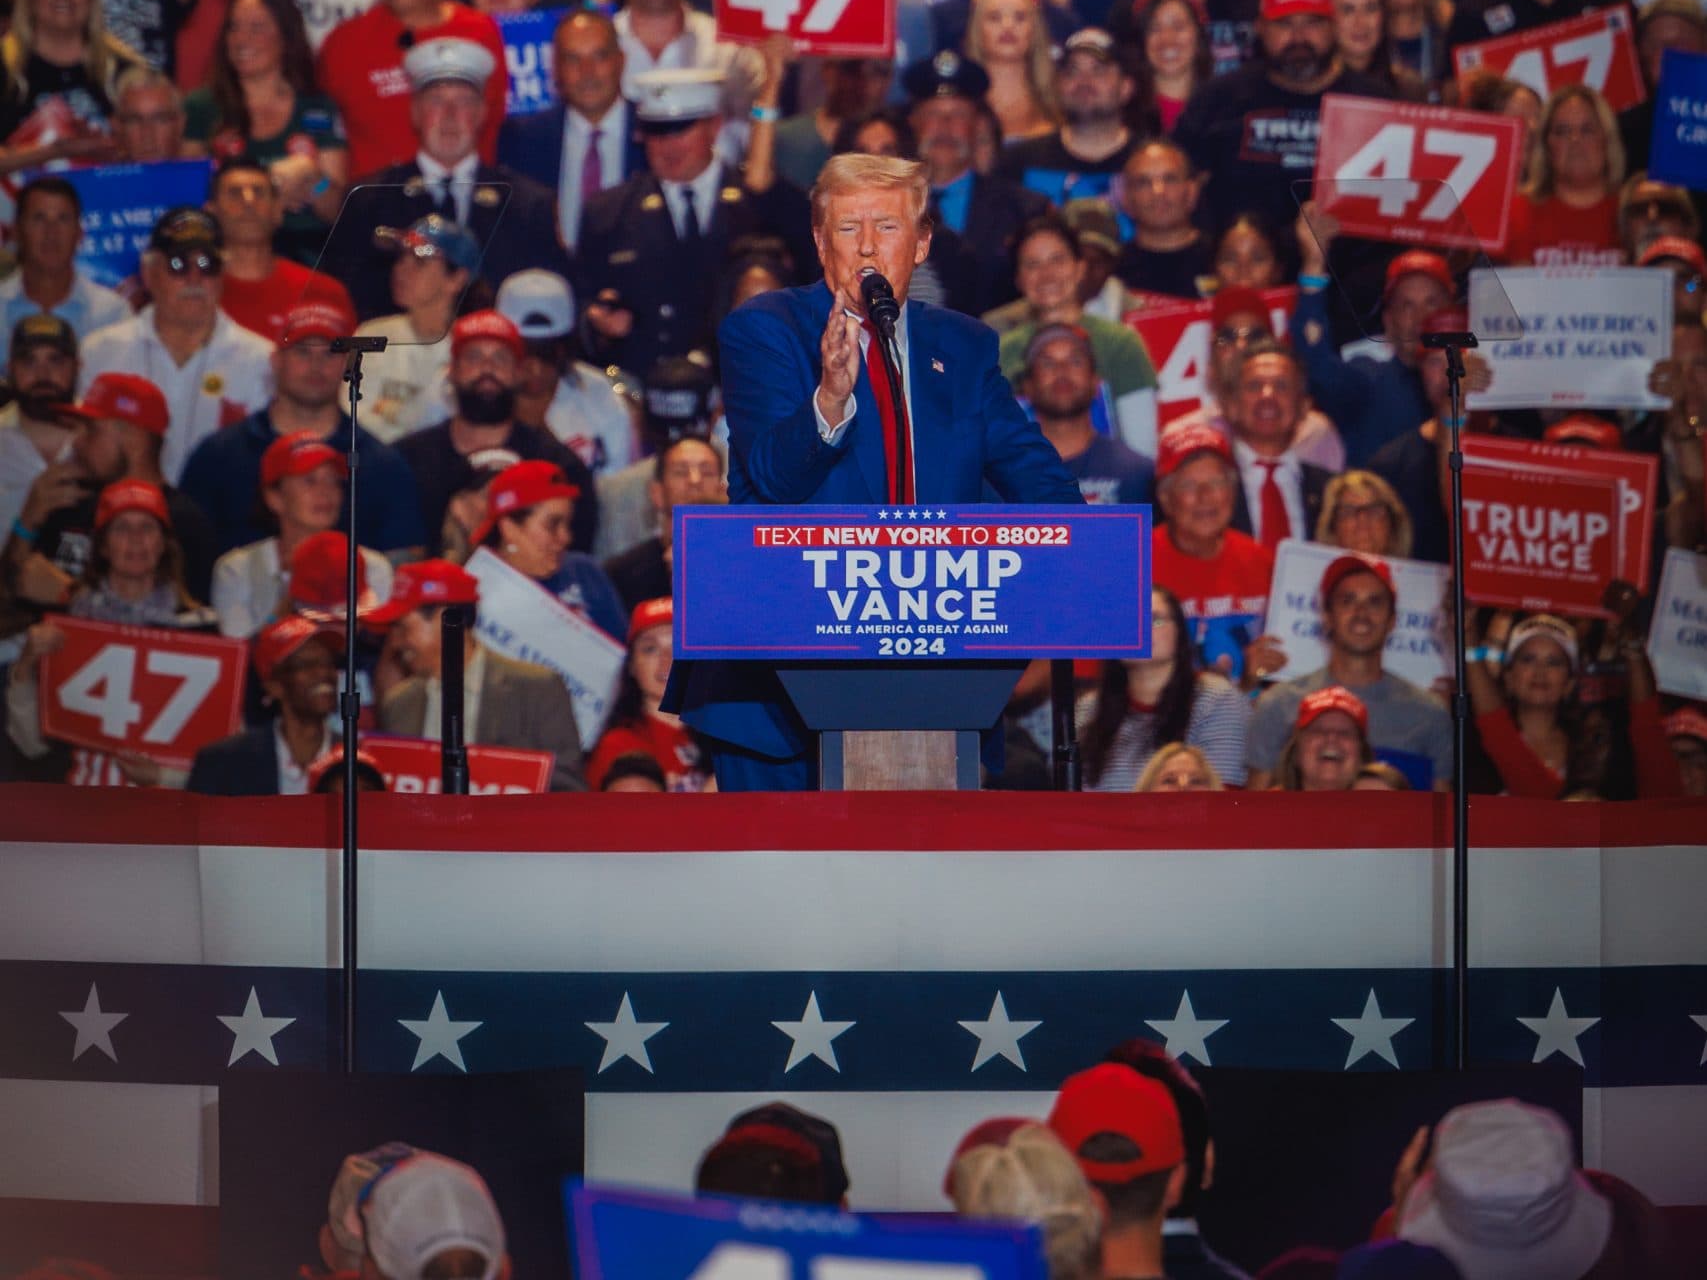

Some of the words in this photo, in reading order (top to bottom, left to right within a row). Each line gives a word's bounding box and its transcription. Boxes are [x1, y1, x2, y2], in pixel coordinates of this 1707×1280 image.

[1335, 123, 1498, 223] 47
[756, 527, 816, 545] TEXT
[823, 527, 885, 545] NEW
[887, 527, 952, 545] YORK
[958, 527, 990, 545] TO
[996, 527, 1069, 545] 88022
[1462, 501, 1610, 545] TRUMP
[803, 549, 1022, 588] TRUMP
[1477, 534, 1593, 572] VANCE
[827, 590, 997, 621] VANCE
[816, 624, 852, 635] MAKE
[856, 624, 914, 635] AMERICA
[918, 624, 959, 635] GREAT
[964, 624, 1009, 635] AGAIN!
[878, 638, 946, 656] 2024
[57, 642, 223, 746] 47
